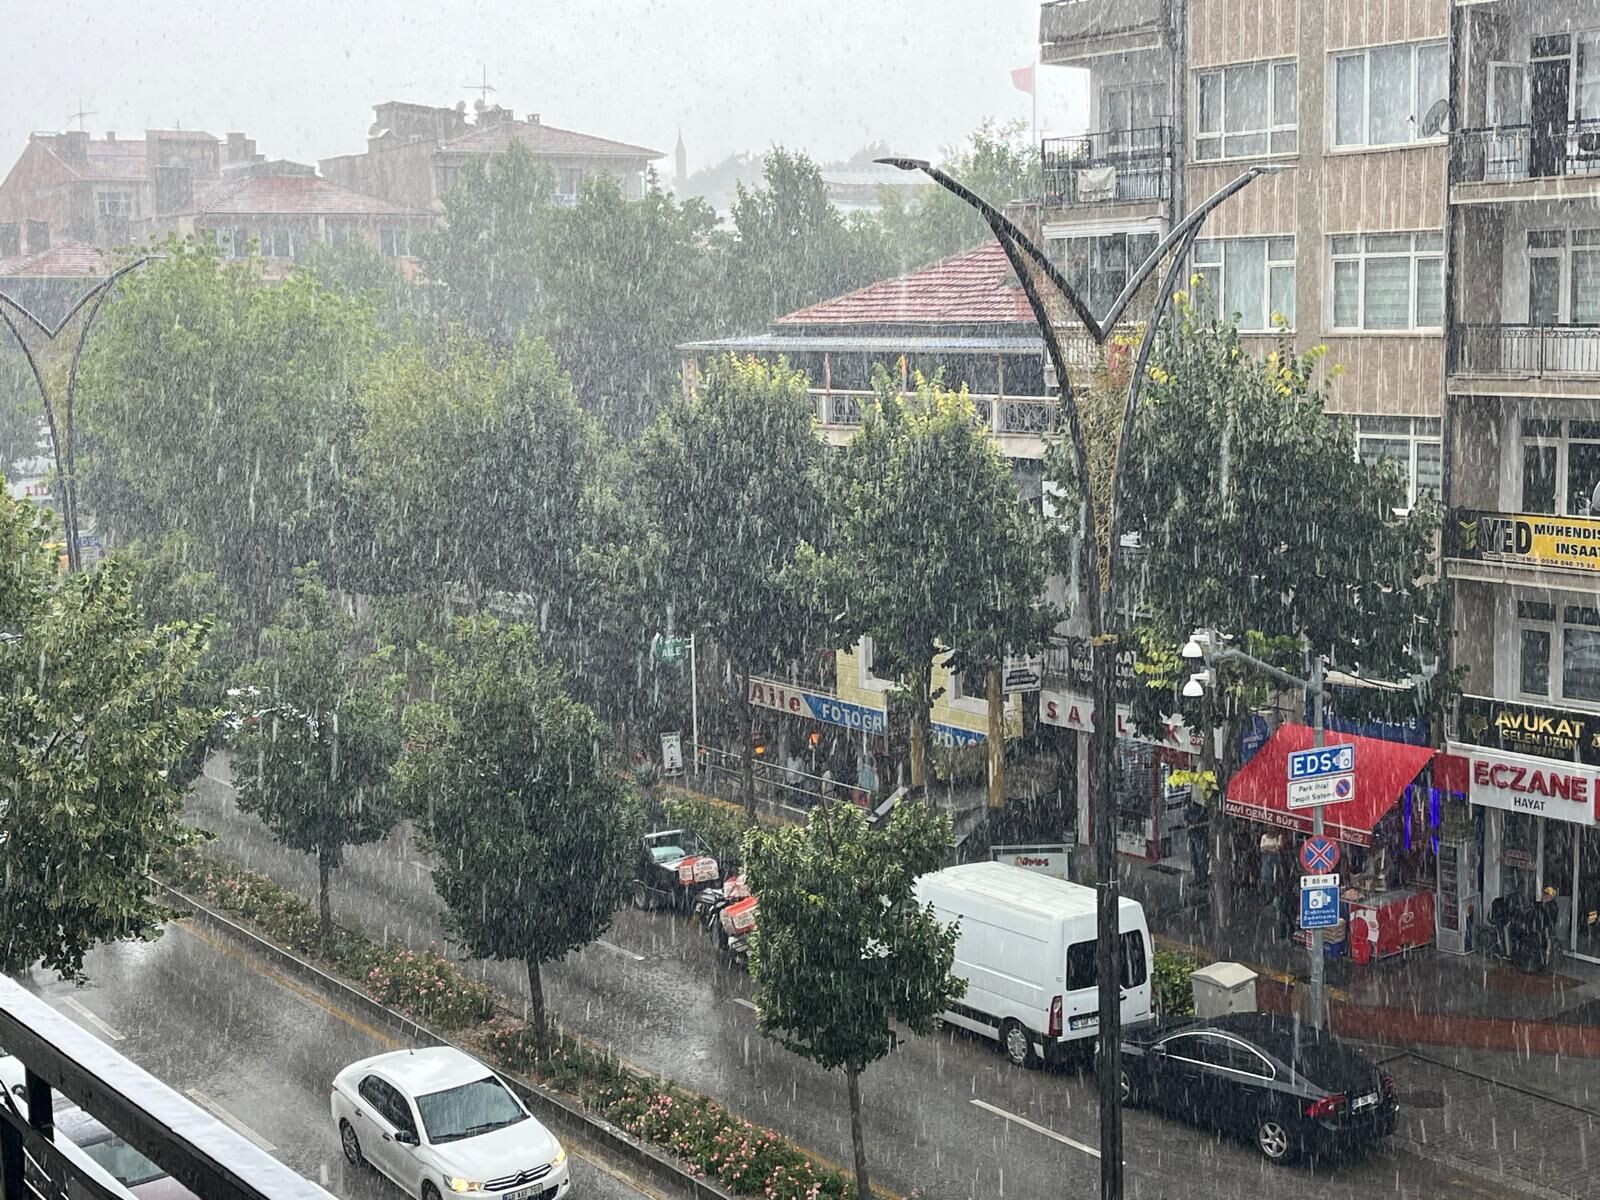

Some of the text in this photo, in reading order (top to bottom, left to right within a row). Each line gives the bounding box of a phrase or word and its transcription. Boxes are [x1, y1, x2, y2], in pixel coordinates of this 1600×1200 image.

[1482, 517, 1532, 554] YED
[750, 684, 801, 712] Aile
[1495, 711, 1585, 738] AVUKAT
[1503, 729, 1540, 745] SELEN
[1544, 736, 1577, 750] UZUN
[1293, 753, 1331, 775] EDS
[1474, 761, 1588, 802] ECZANE
[1514, 797, 1546, 811] HAYAT
